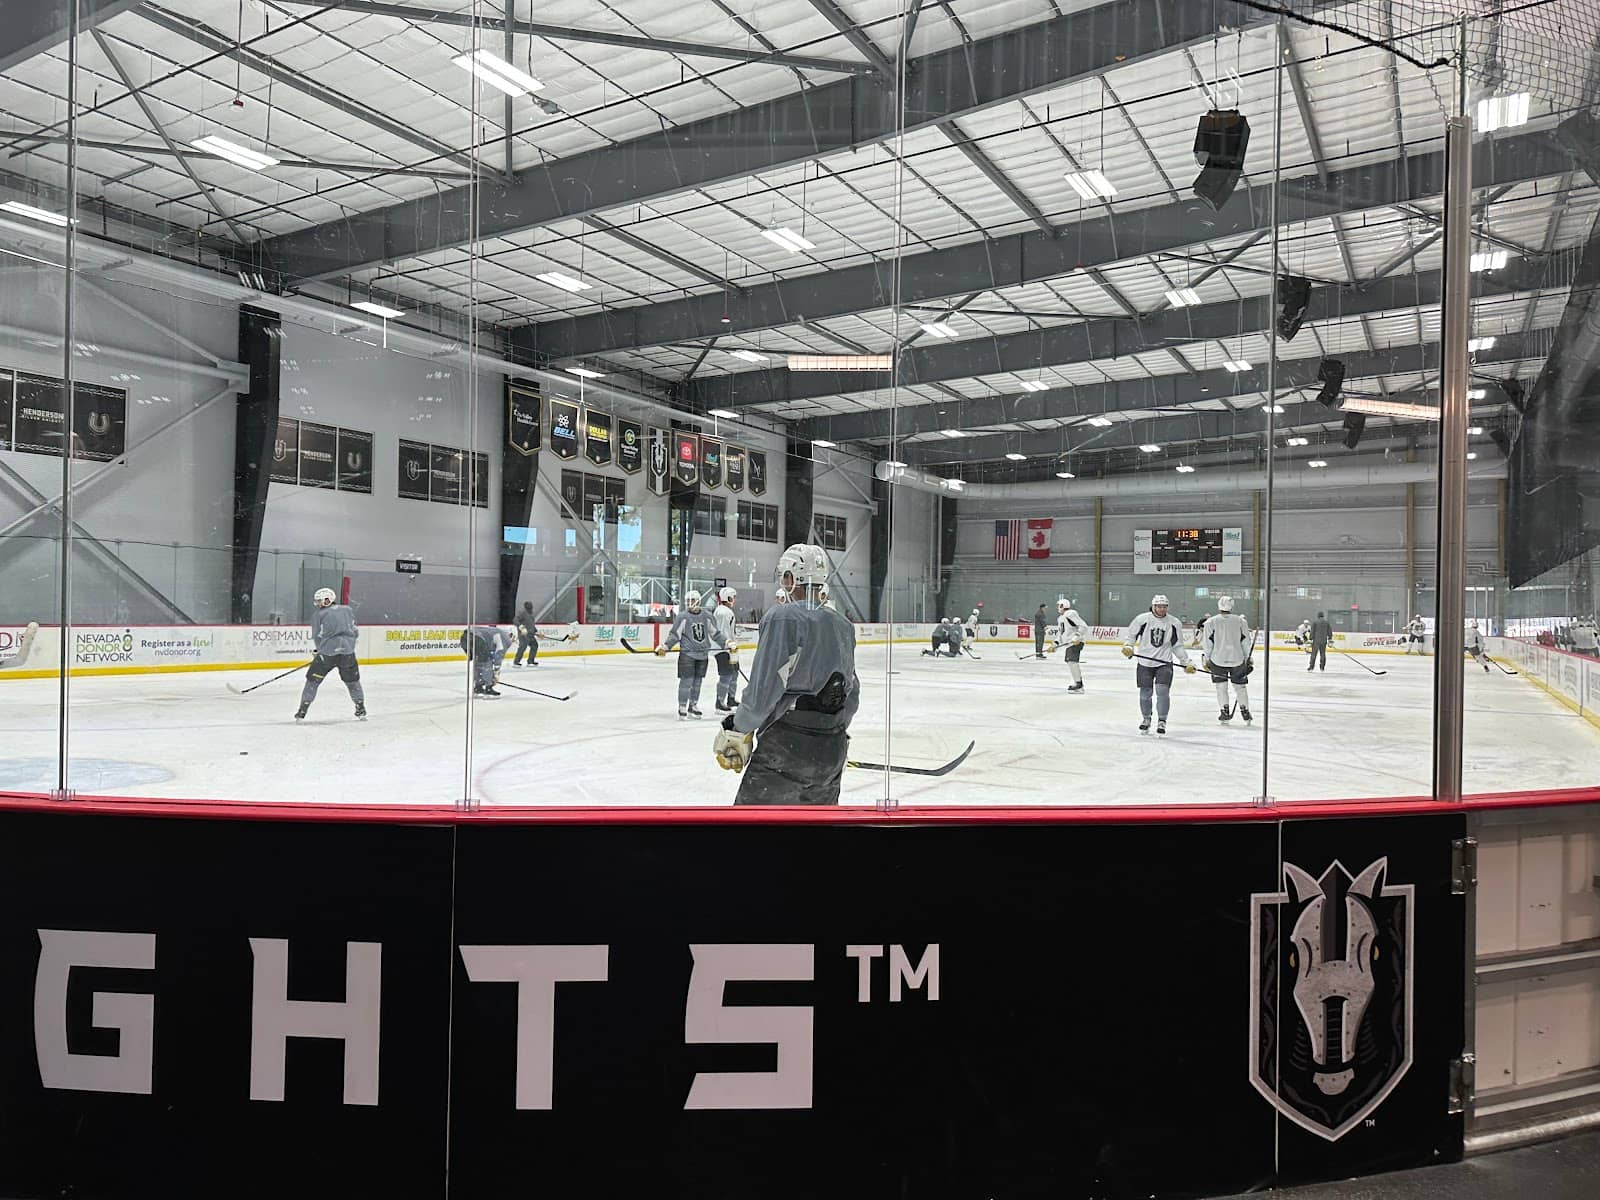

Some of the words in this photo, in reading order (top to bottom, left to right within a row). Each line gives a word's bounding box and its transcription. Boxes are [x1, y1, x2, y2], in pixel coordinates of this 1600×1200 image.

[23, 408, 64, 420] HENDERSON
[1177, 530, 1198, 538] 11:30
[76, 634, 121, 644] NEVADA
[253, 631, 303, 641] ROSEMAN
[385, 630, 421, 641] DOLLAR
[423, 629, 447, 641] LOAN
[76, 643, 121, 653] DONOR
[141, 639, 175, 648] Register
[76, 652, 133, 662] NETWORK
[154, 648, 202, 656] nvdonor.org
[1365, 1119, 1376, 1127] TM
